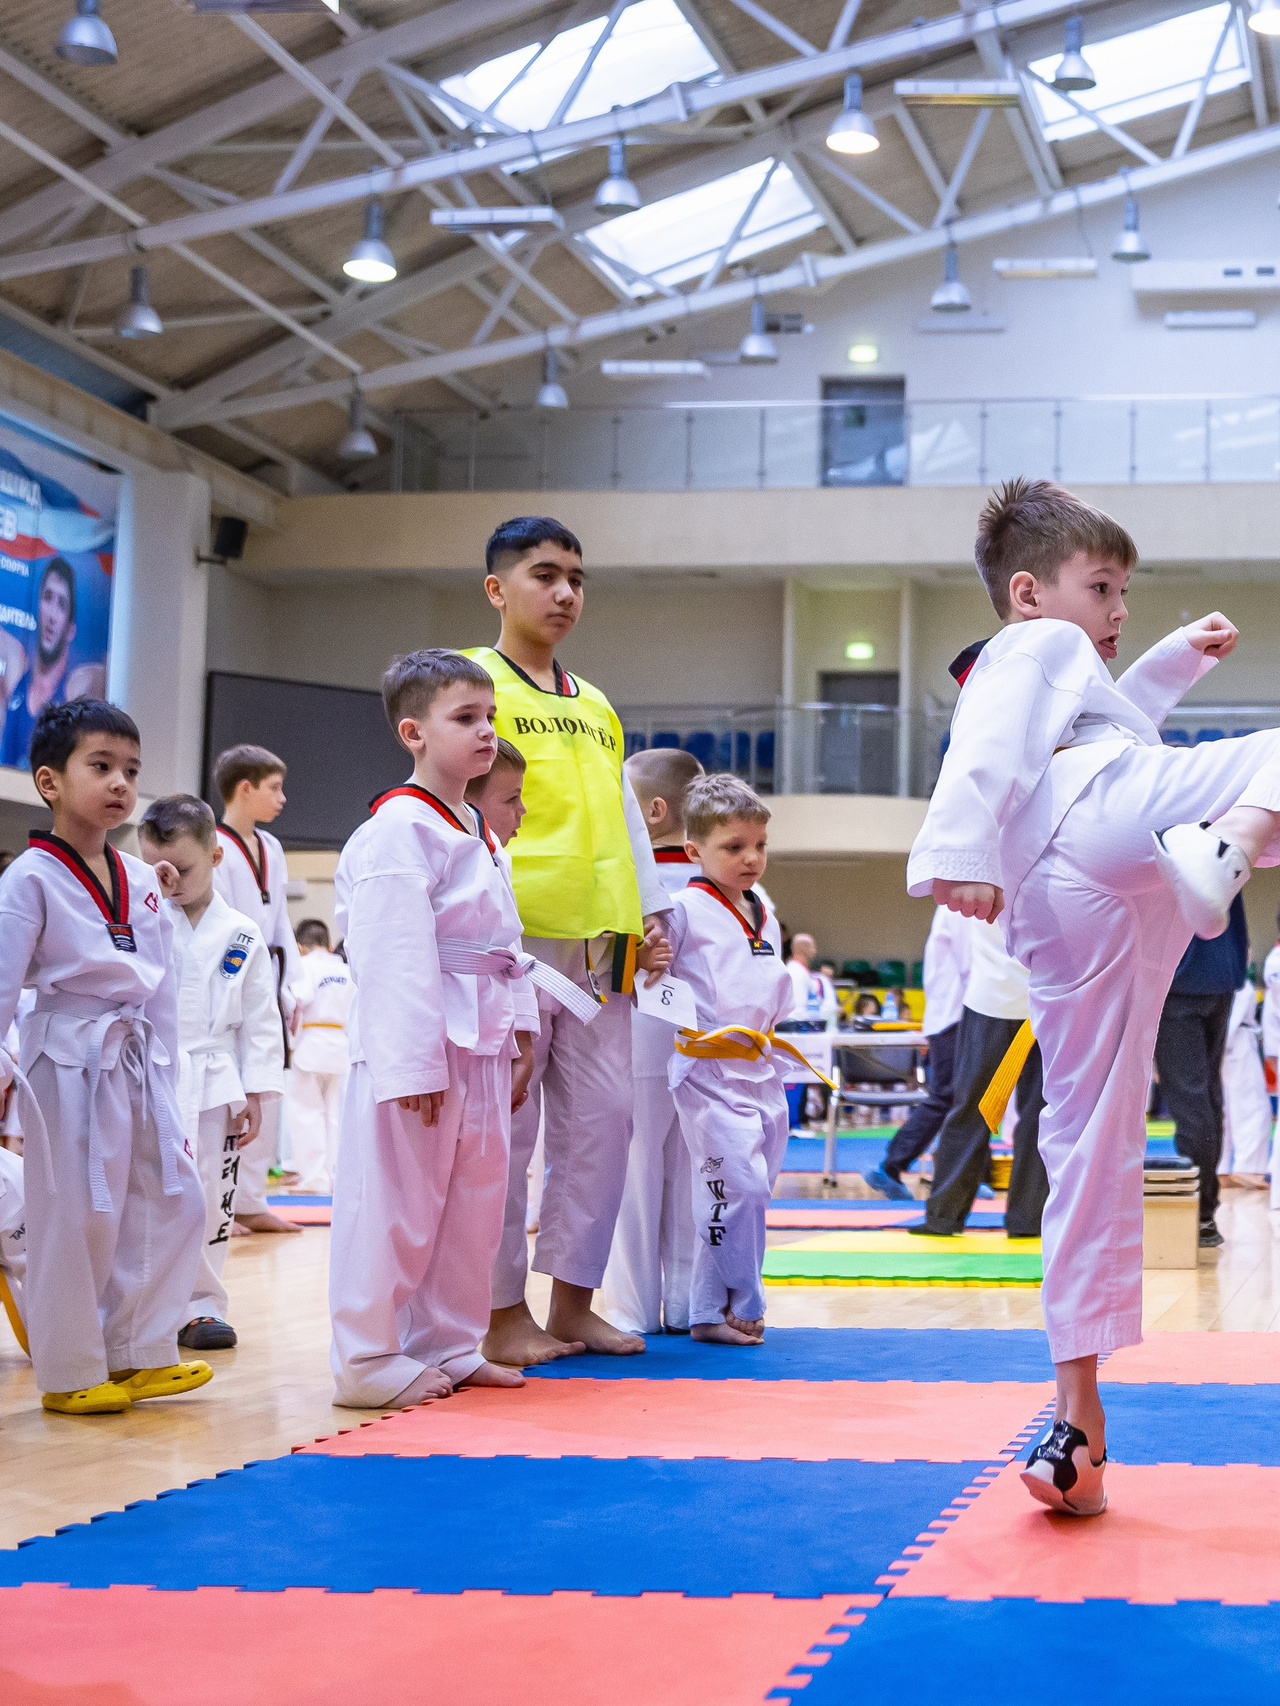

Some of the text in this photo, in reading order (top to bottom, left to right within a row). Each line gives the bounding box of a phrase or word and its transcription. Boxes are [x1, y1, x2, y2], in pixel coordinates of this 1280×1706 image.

[513, 716, 616, 752] ВОЛОНТЁР
[237, 932, 255, 946] ITF
[706, 1179, 729, 1247] WTF
